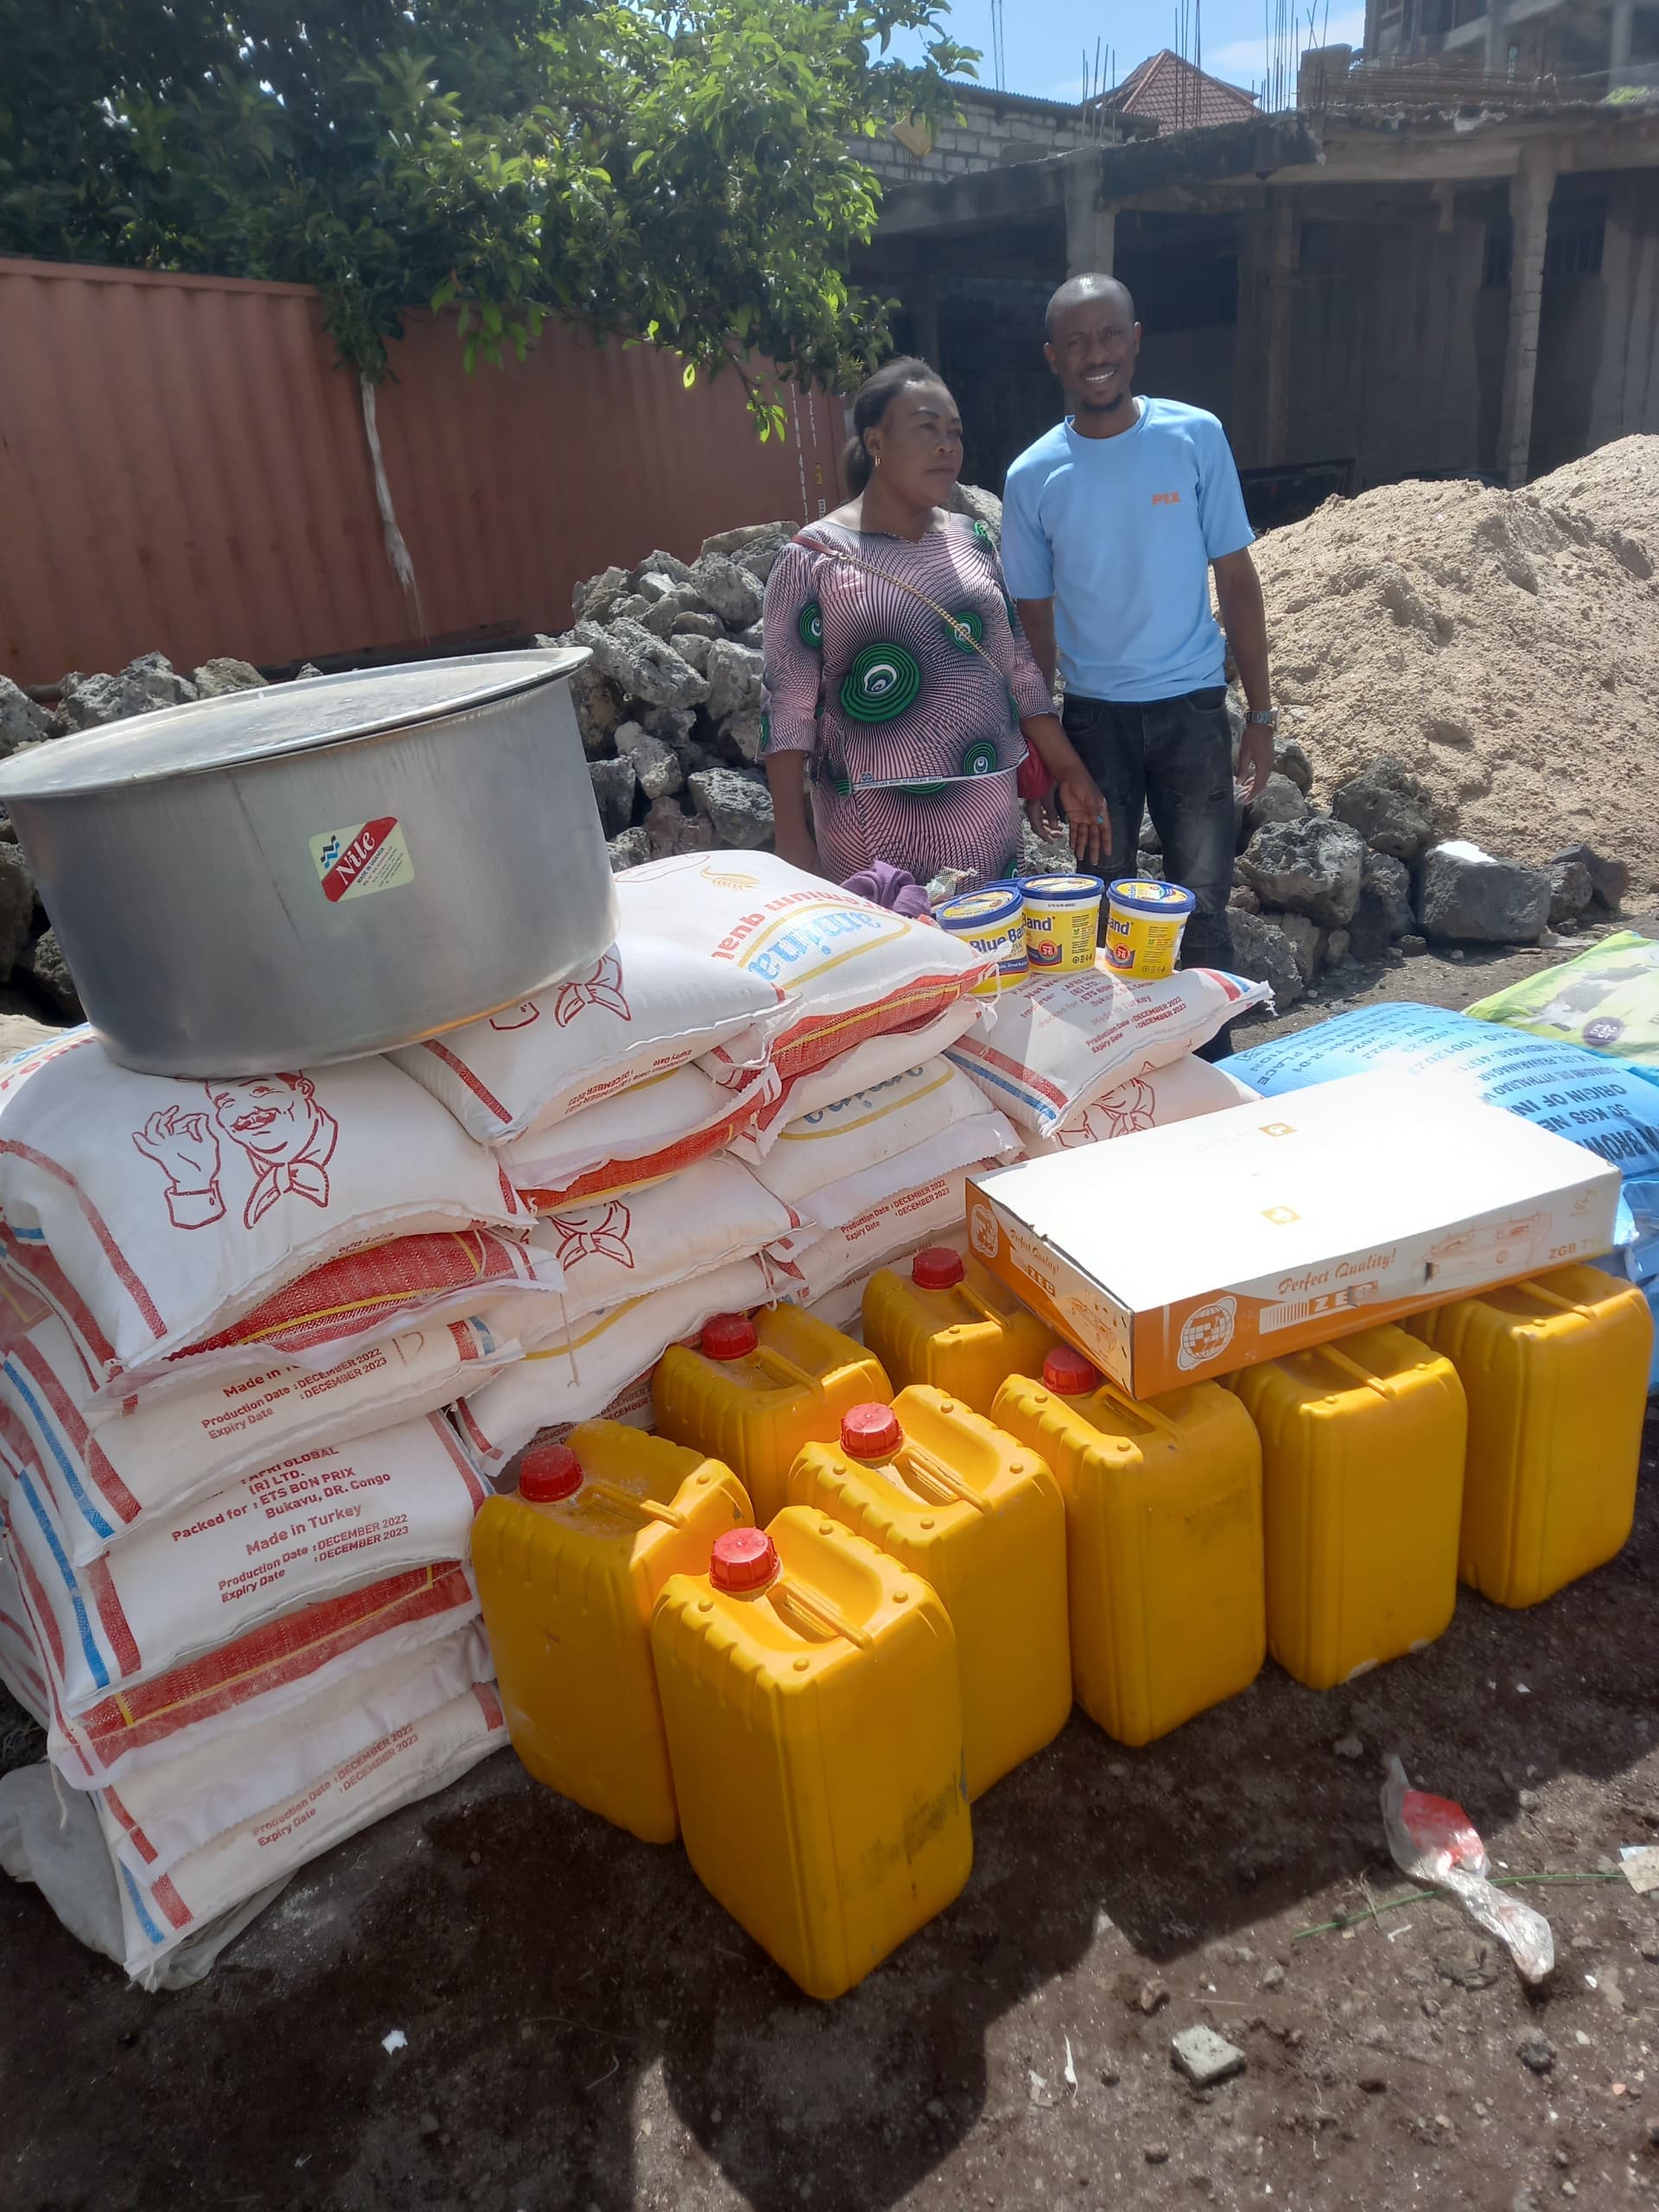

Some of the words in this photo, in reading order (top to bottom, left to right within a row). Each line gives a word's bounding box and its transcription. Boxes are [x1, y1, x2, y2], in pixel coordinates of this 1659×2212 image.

[335, 831, 376, 886] Nile
[969, 936, 1007, 953] Blue
[1541, 1093, 1568, 1108] OF
[1564, 1084, 1627, 1103] ORIGIN
[1568, 1108, 1610, 1125] KGS
[1611, 1103, 1632, 1118] 50
[841, 1212, 874, 1234] Production
[874, 1205, 890, 1217] Date
[930, 1179, 947, 1192] 2022
[845, 1228, 866, 1242] Expiry
[865, 1220, 880, 1232] Date
[933, 1187, 950, 1199] 2023
[1278, 1270, 1330, 1295] Perfect
[1334, 1247, 1397, 1279] Quality!
[200, 1398, 265, 1429] Production
[264, 1385, 291, 1402] Date
[355, 1348, 382, 1363] 2022
[208, 1419, 247, 1440] Expiry
[247, 1407, 274, 1425] Date
[361, 1357, 388, 1374] 2023
[223, 1376, 264, 1398] Made
[267, 1369, 281, 1381] in
[248, 1479, 271, 1496] (R)
[273, 1469, 305, 1484] LTD.
[283, 1446, 340, 1469] GLOBAL
[171, 1514, 226, 1541] Packed
[226, 1504, 249, 1520] for
[259, 1488, 288, 1507] ETS
[289, 1476, 321, 1494] BON
[321, 1467, 356, 1484] PRIX
[265, 1494, 323, 1519] Bukavu,
[323, 1484, 349, 1498] DR.
[350, 1473, 391, 1490] Congo
[218, 1558, 282, 1592] Production
[282, 1546, 309, 1563] Date
[382, 1514, 408, 1529] 2022
[245, 1530, 289, 1556] Made
[290, 1524, 307, 1536] in
[308, 1503, 362, 1529] Turkey
[220, 1580, 258, 1604] Expiry
[259, 1568, 286, 1588] Date
[382, 1526, 409, 1541] 2023
[252, 1798, 308, 1836] Production
[308, 1780, 332, 1802] Date
[257, 1824, 292, 1847] Expiry
[293, 1807, 317, 1828] Date
[396, 1732, 419, 1754] 2023
